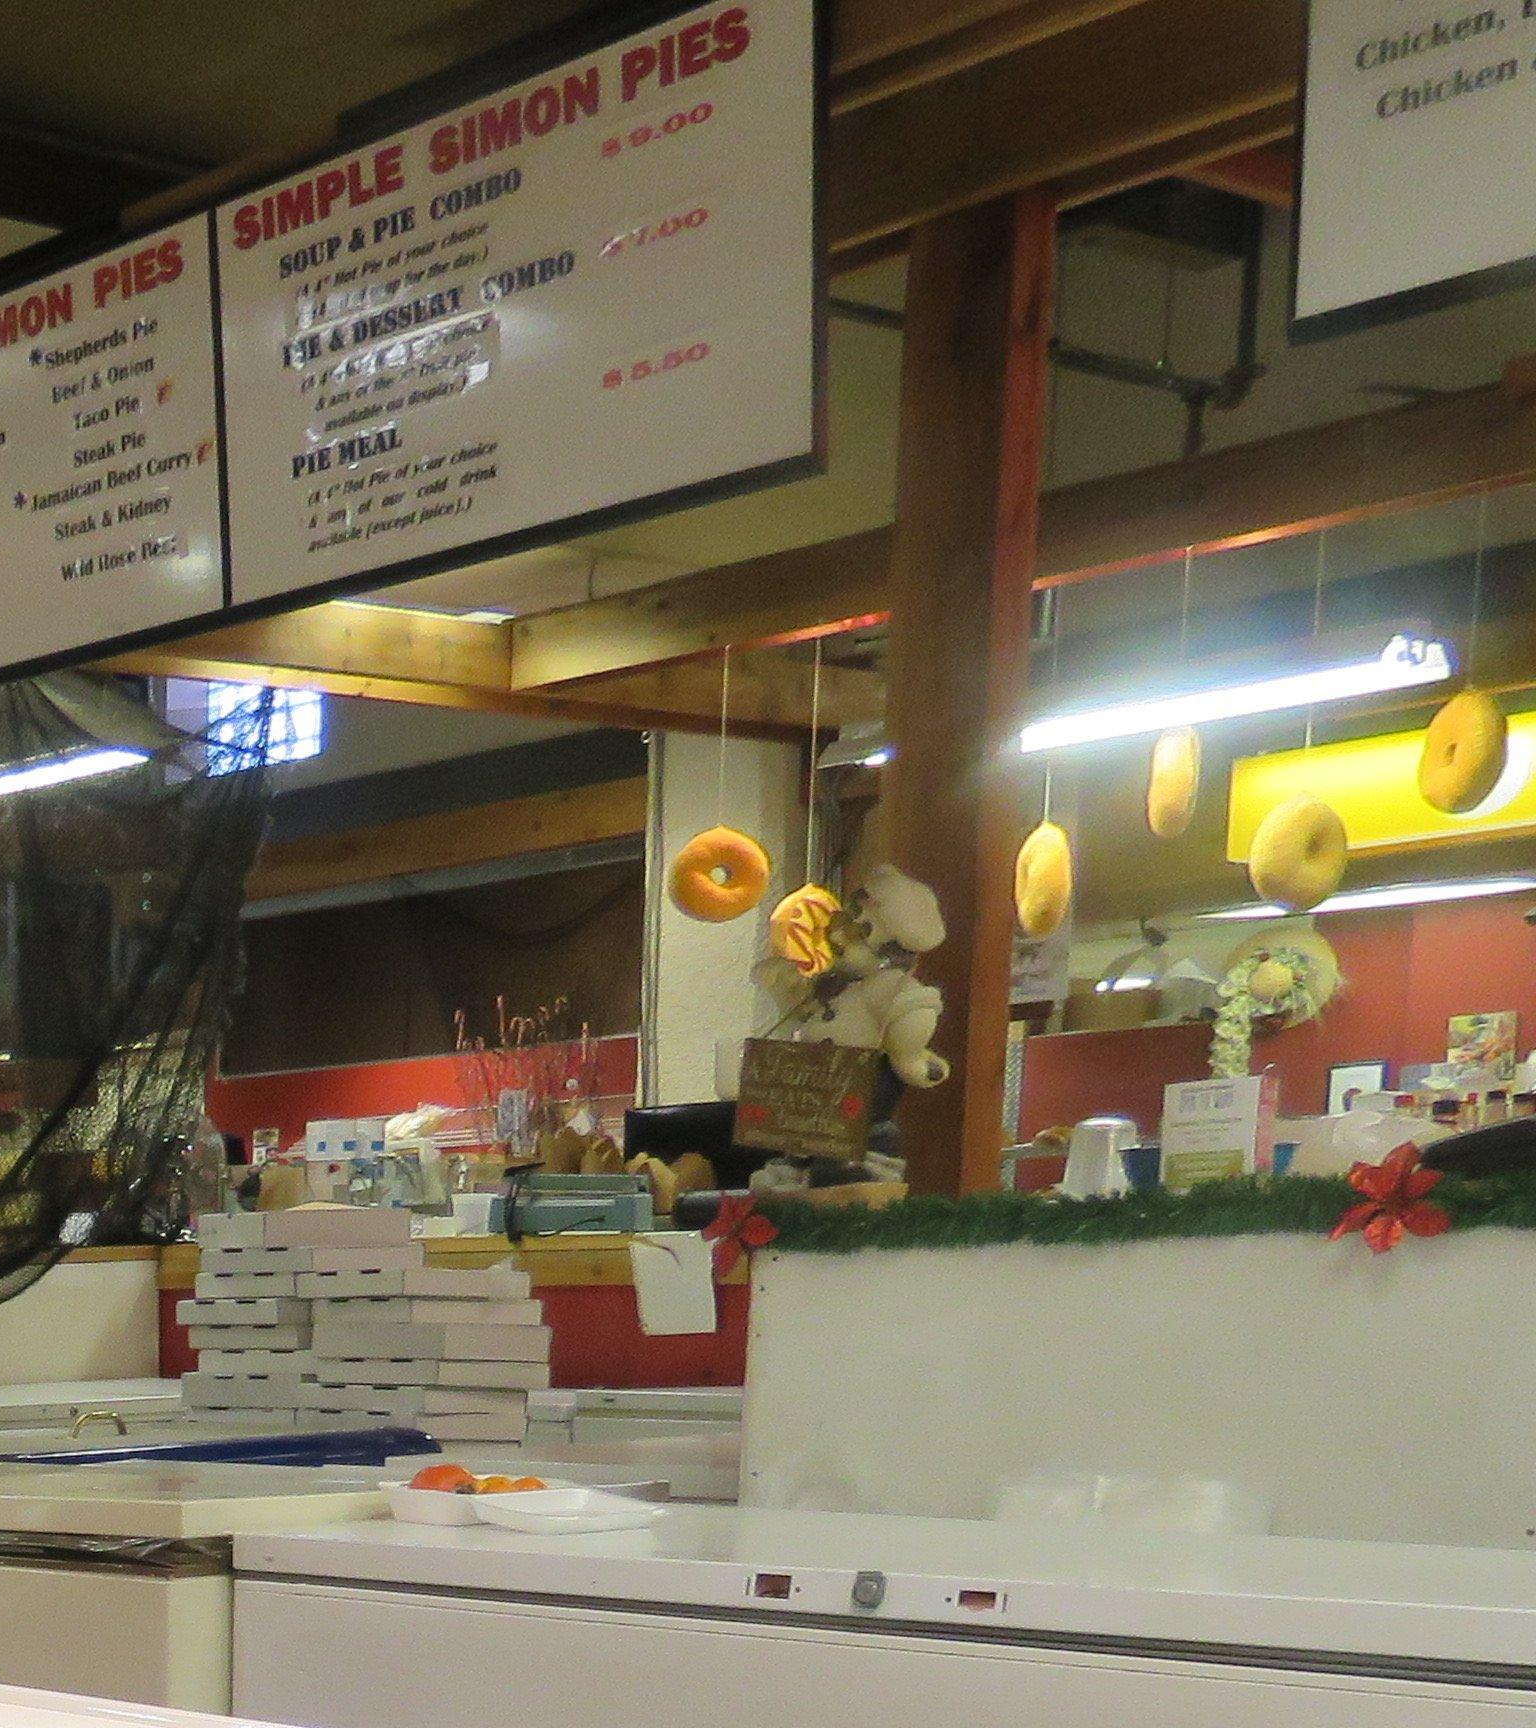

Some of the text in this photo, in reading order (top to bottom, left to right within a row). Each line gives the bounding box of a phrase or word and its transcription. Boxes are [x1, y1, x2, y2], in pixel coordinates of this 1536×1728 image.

[1355, 9, 1507, 72] Chicken,
[1376, 58, 1520, 120] Chicken
[232, 7, 751, 251] SIMPLE SIMON PIES
[280, 167, 523, 280] SOUP & PIE COMBO
[93, 239, 185, 310] PIES
[352, 284, 464, 343] DESSERT
[481, 249, 576, 302] COMBO
[44, 316, 159, 371] Shepherds Pie
[51, 377, 87, 405] Beef
[106, 356, 155, 386] Onion
[72, 394, 141, 432] Taco Pie
[73, 430, 147, 469] Steak Pie
[292, 428, 403, 480] PIE MEAL
[30, 450, 193, 514] Jamaican Beef Curry
[53, 493, 172, 542] Steak & Kidney
